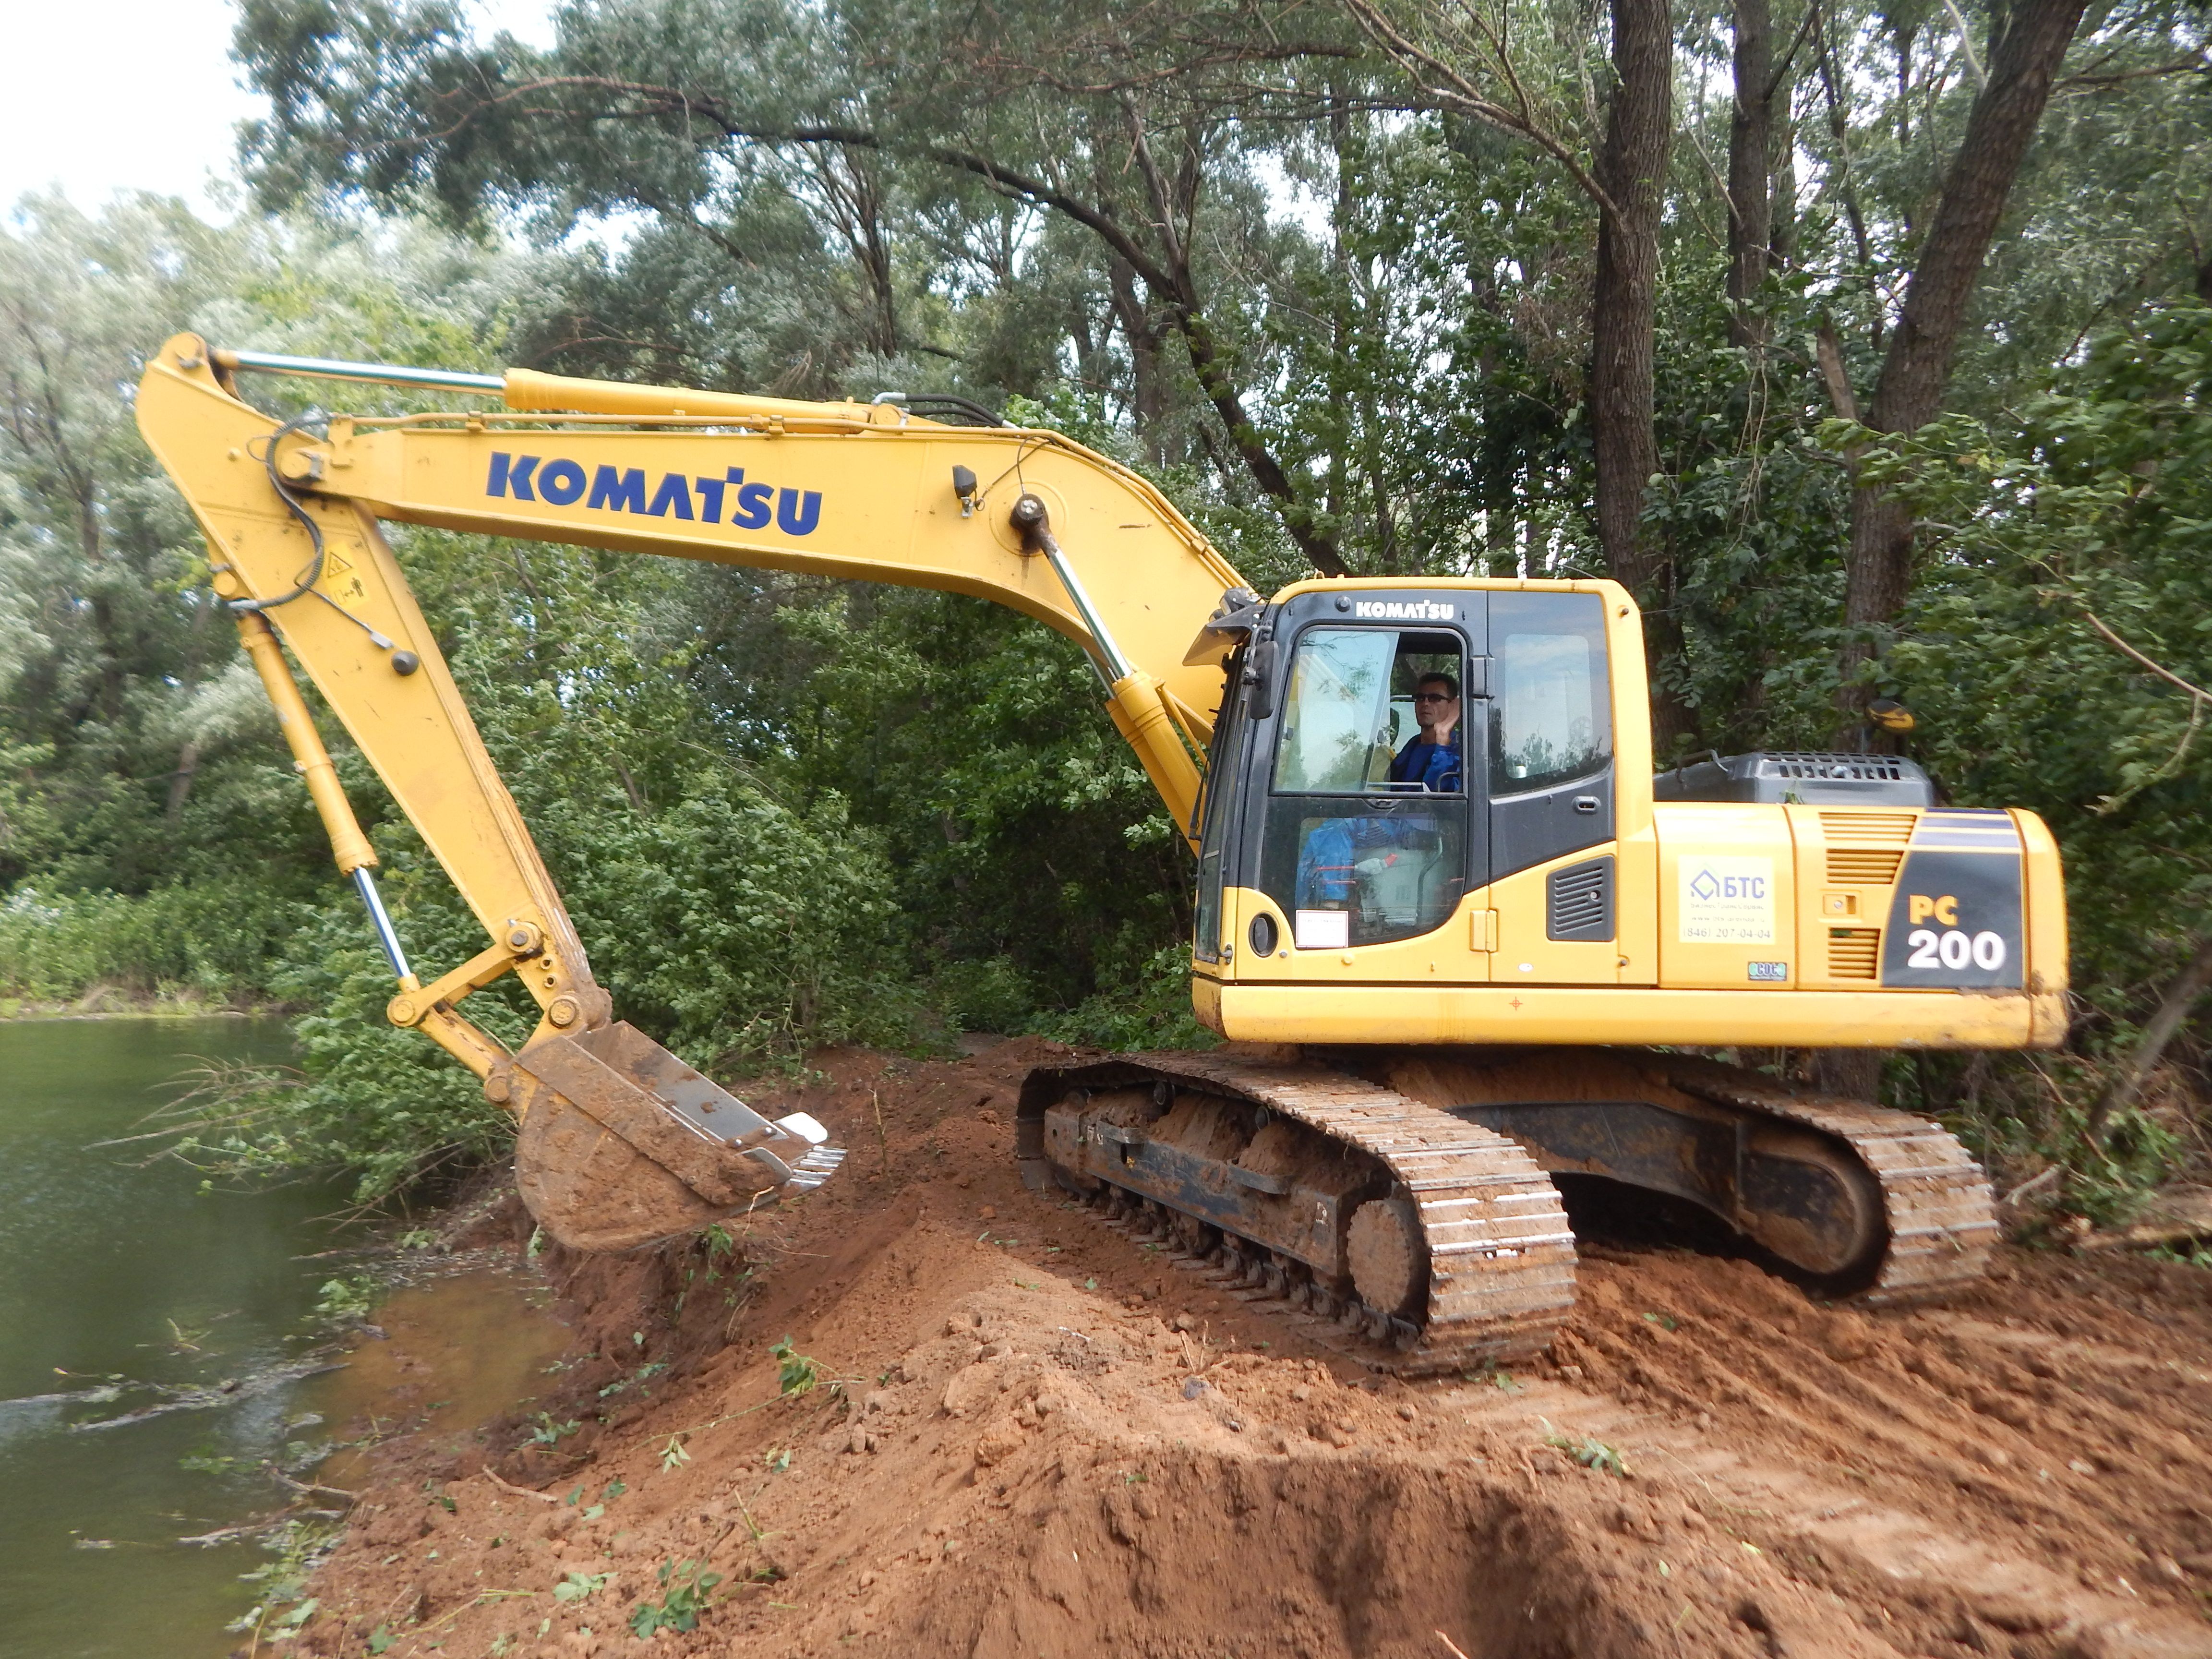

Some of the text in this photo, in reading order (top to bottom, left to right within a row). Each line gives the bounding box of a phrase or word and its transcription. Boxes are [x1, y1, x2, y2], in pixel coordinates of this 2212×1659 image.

[486, 451, 822, 536] KOMATSU
[1356, 599, 1454, 620] KOMATSU
[1724, 877, 1765, 899] БТС
[1909, 894, 1959, 926] PC
[1683, 927, 1771, 938] (846) 207-04-04
[1907, 929, 2007, 971] 200
